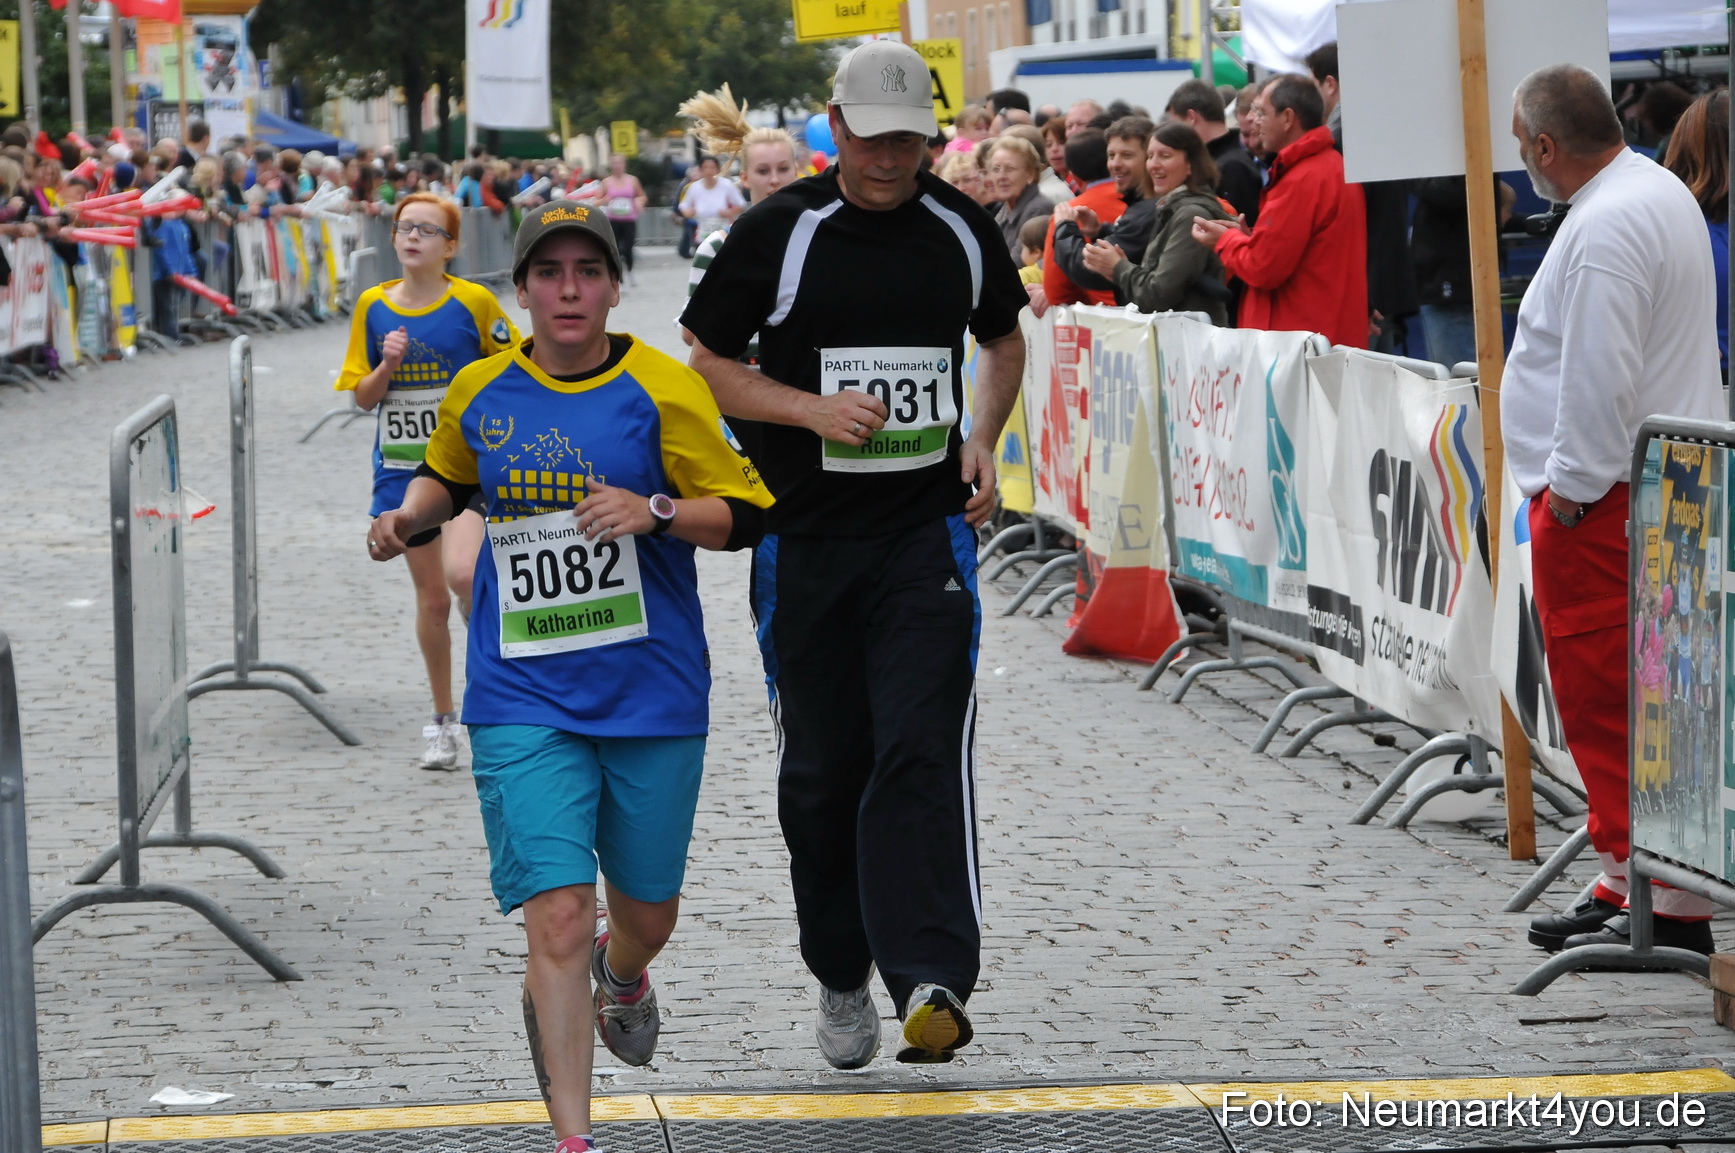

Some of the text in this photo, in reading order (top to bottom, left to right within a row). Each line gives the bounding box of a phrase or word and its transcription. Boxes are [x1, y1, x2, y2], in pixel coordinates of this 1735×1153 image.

[834, 3, 867, 18] lauf
[540, 213, 588, 225] Wolfskin
[543, 207, 566, 218] Jack
[825, 360, 933, 372] PARTL Neumarkt
[386, 409, 438, 440] 550
[491, 418, 502, 427] 15
[485, 429, 505, 437] Jahre
[861, 435, 922, 455] Roland
[1672, 491, 1701, 535] erdgas
[492, 533, 536, 549] PARTL
[509, 540, 625, 603] 5082
[526, 607, 615, 637] Katharina
